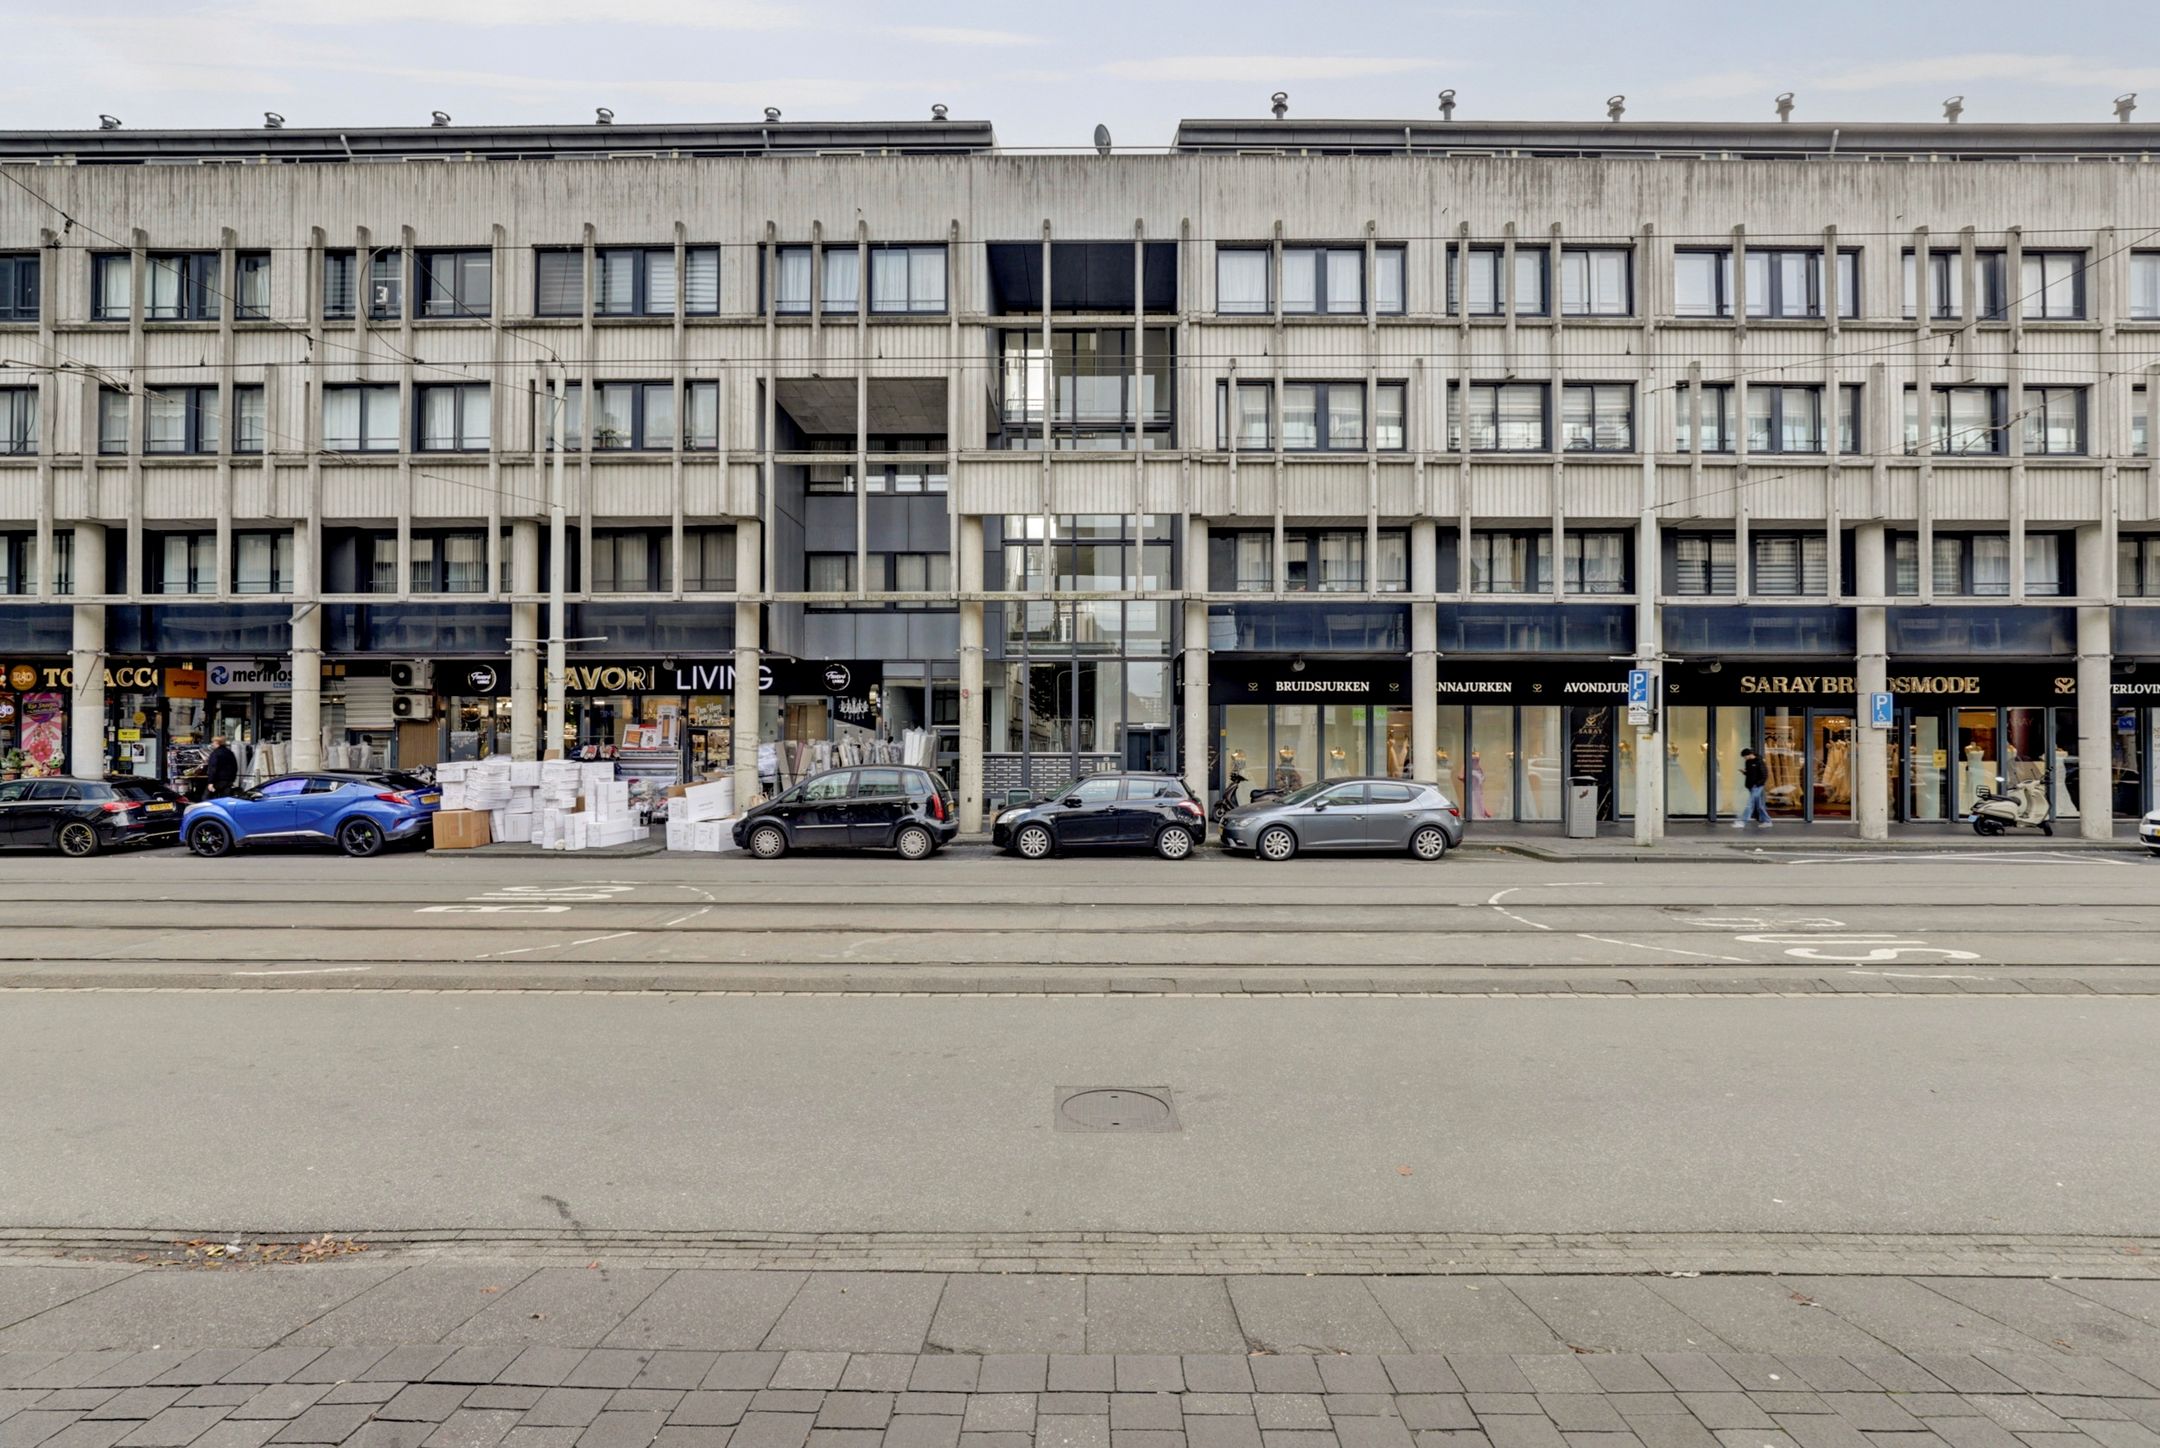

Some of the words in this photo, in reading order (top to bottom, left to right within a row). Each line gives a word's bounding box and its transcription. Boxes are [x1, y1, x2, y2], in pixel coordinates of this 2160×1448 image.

[43, 668, 158, 687] TOACC
[1633, 673, 1644, 689] P
[1740, 676, 1819, 694] SARAY
[1822, 676, 1980, 694] BRSMODE
[1276, 681, 1369, 692] BRUIDSJURKEN
[1437, 682, 1512, 693] NNAJURKEN
[1564, 682, 1629, 693] AVONDJUR
[1876, 695, 1888, 710] P
